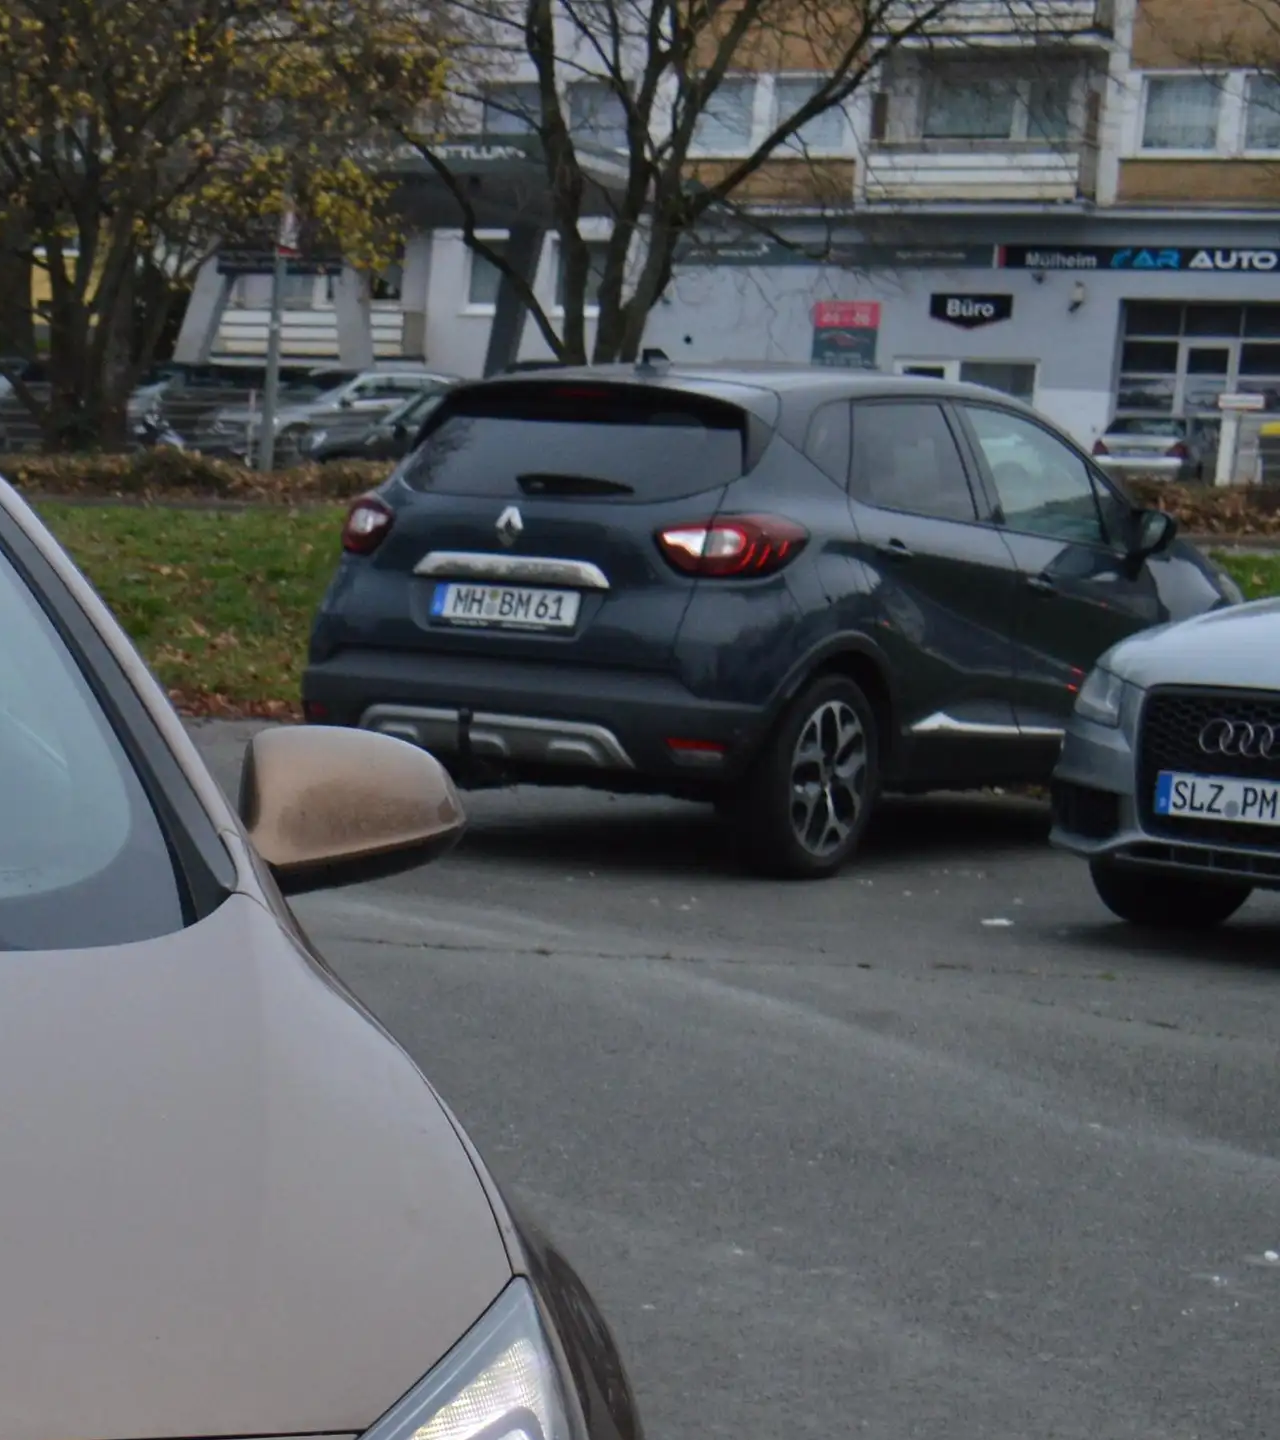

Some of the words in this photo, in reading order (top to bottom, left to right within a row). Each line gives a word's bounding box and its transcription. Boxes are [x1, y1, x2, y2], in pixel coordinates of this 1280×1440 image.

[1025, 249, 1098, 269] Mülheim
[1188, 250, 1278, 269] AUTO
[946, 298, 995, 317] Büro
[452, 587, 486, 615] MH
[498, 591, 532, 618] BM
[534, 594, 565, 621] 61
[1172, 780, 1224, 814] SLZ
[1241, 786, 1278, 819] PM
